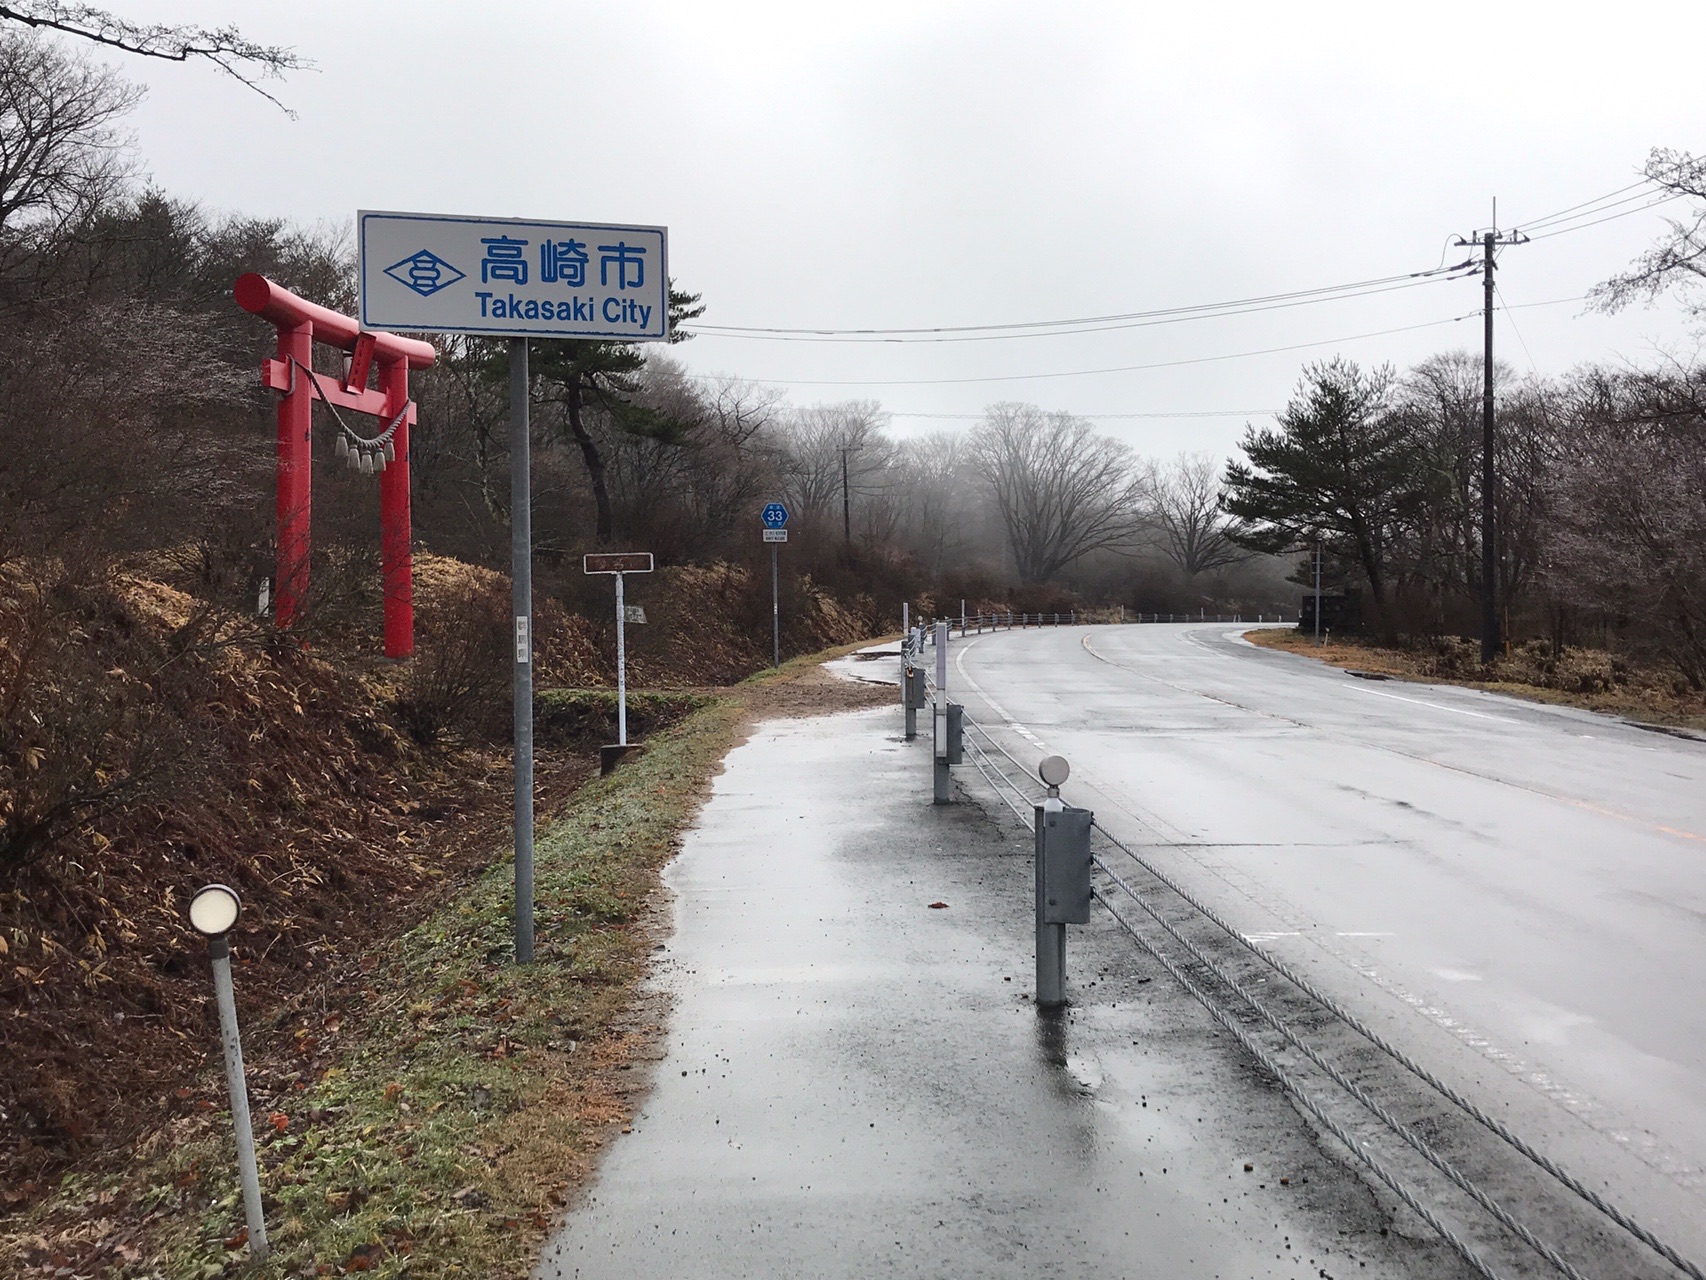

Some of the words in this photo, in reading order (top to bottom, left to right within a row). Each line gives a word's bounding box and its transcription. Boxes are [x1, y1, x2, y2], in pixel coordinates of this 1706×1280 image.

[480, 235, 647, 290] 高崎市
[475, 292, 594, 322] Takasaki
[602, 297, 652, 329] City
[767, 510, 783, 521] 33
